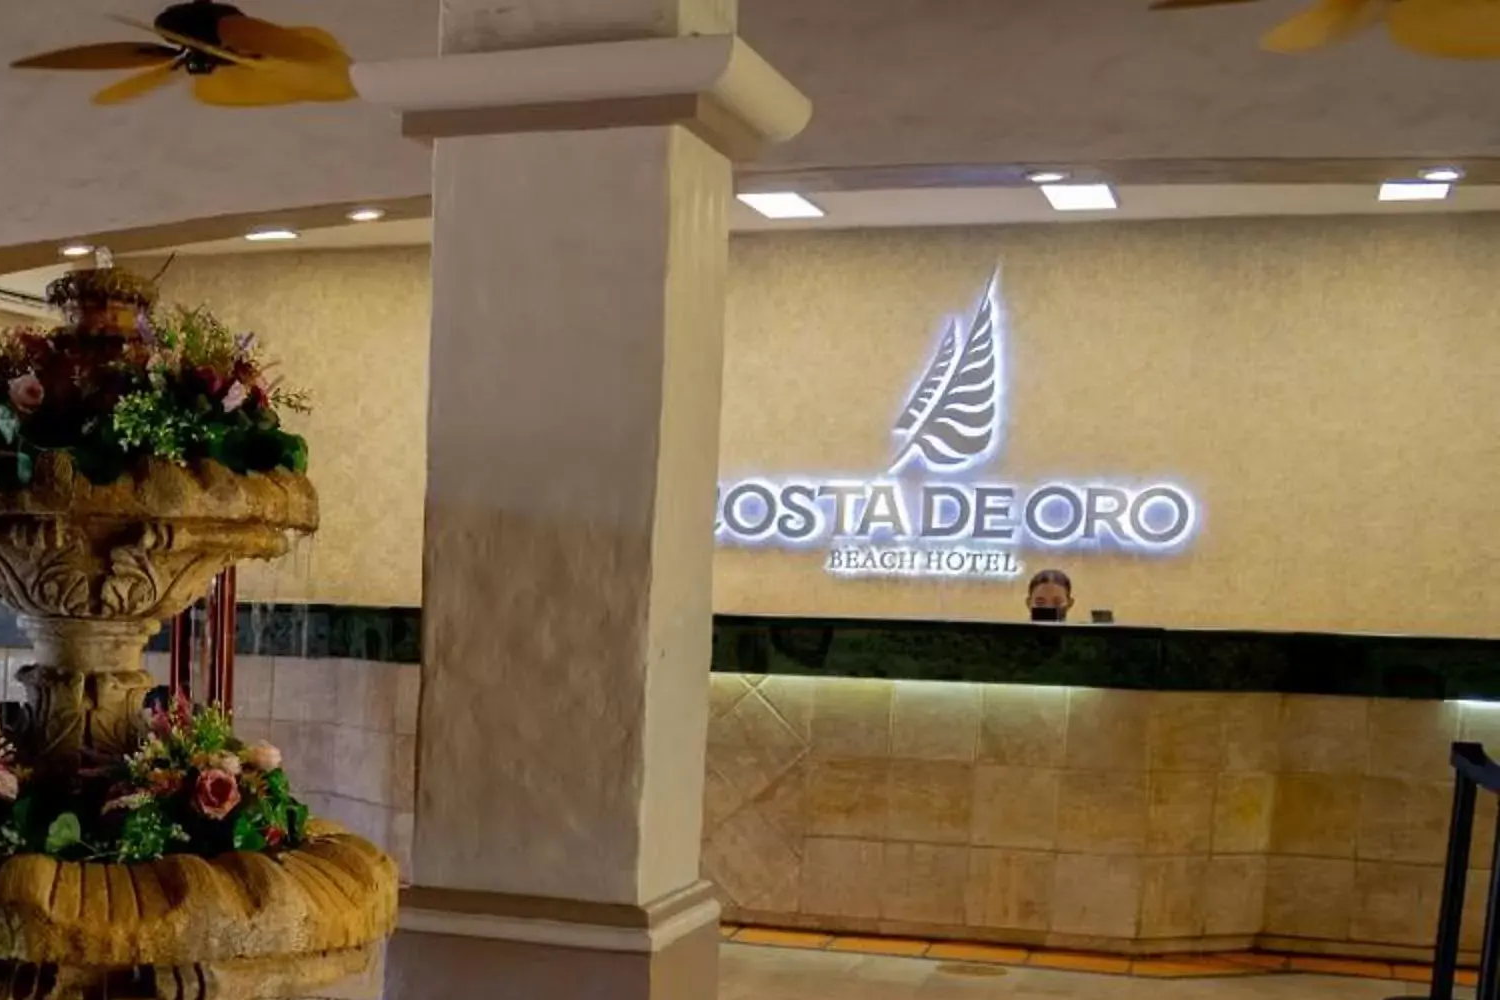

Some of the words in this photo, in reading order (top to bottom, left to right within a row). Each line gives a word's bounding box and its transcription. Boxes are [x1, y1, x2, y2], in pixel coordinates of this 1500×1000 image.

[715, 483, 905, 539] OSTA
[921, 485, 1014, 538] DE
[1025, 486, 1190, 542] ORO
[828, 550, 915, 570] BEACH
[926, 551, 1018, 573] HOTEL
